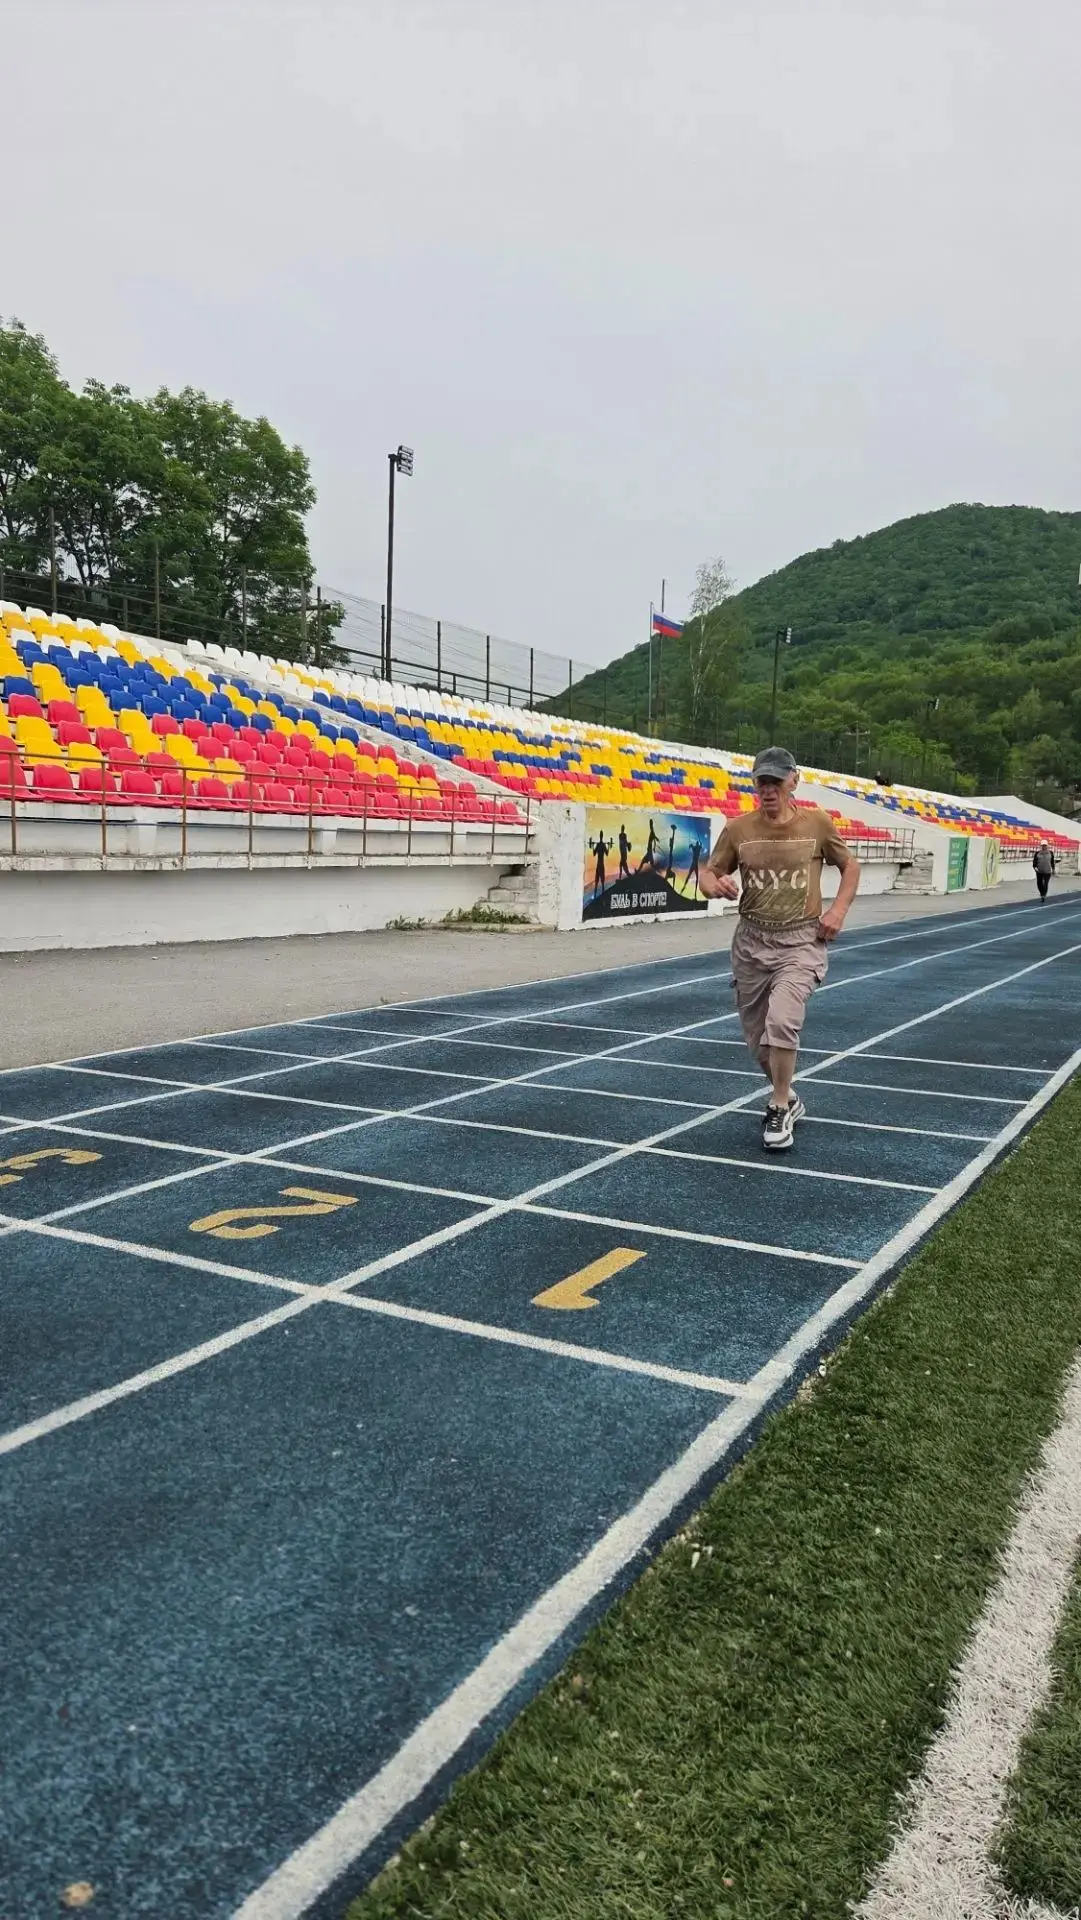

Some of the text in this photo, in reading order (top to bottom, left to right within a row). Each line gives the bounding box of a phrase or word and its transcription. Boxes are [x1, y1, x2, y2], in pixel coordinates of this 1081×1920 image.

[748, 869, 807, 889] NYC
[632, 893, 639, 908] В
[189, 1187, 359, 1239] 2
[530, 1247, 648, 1310] 1
